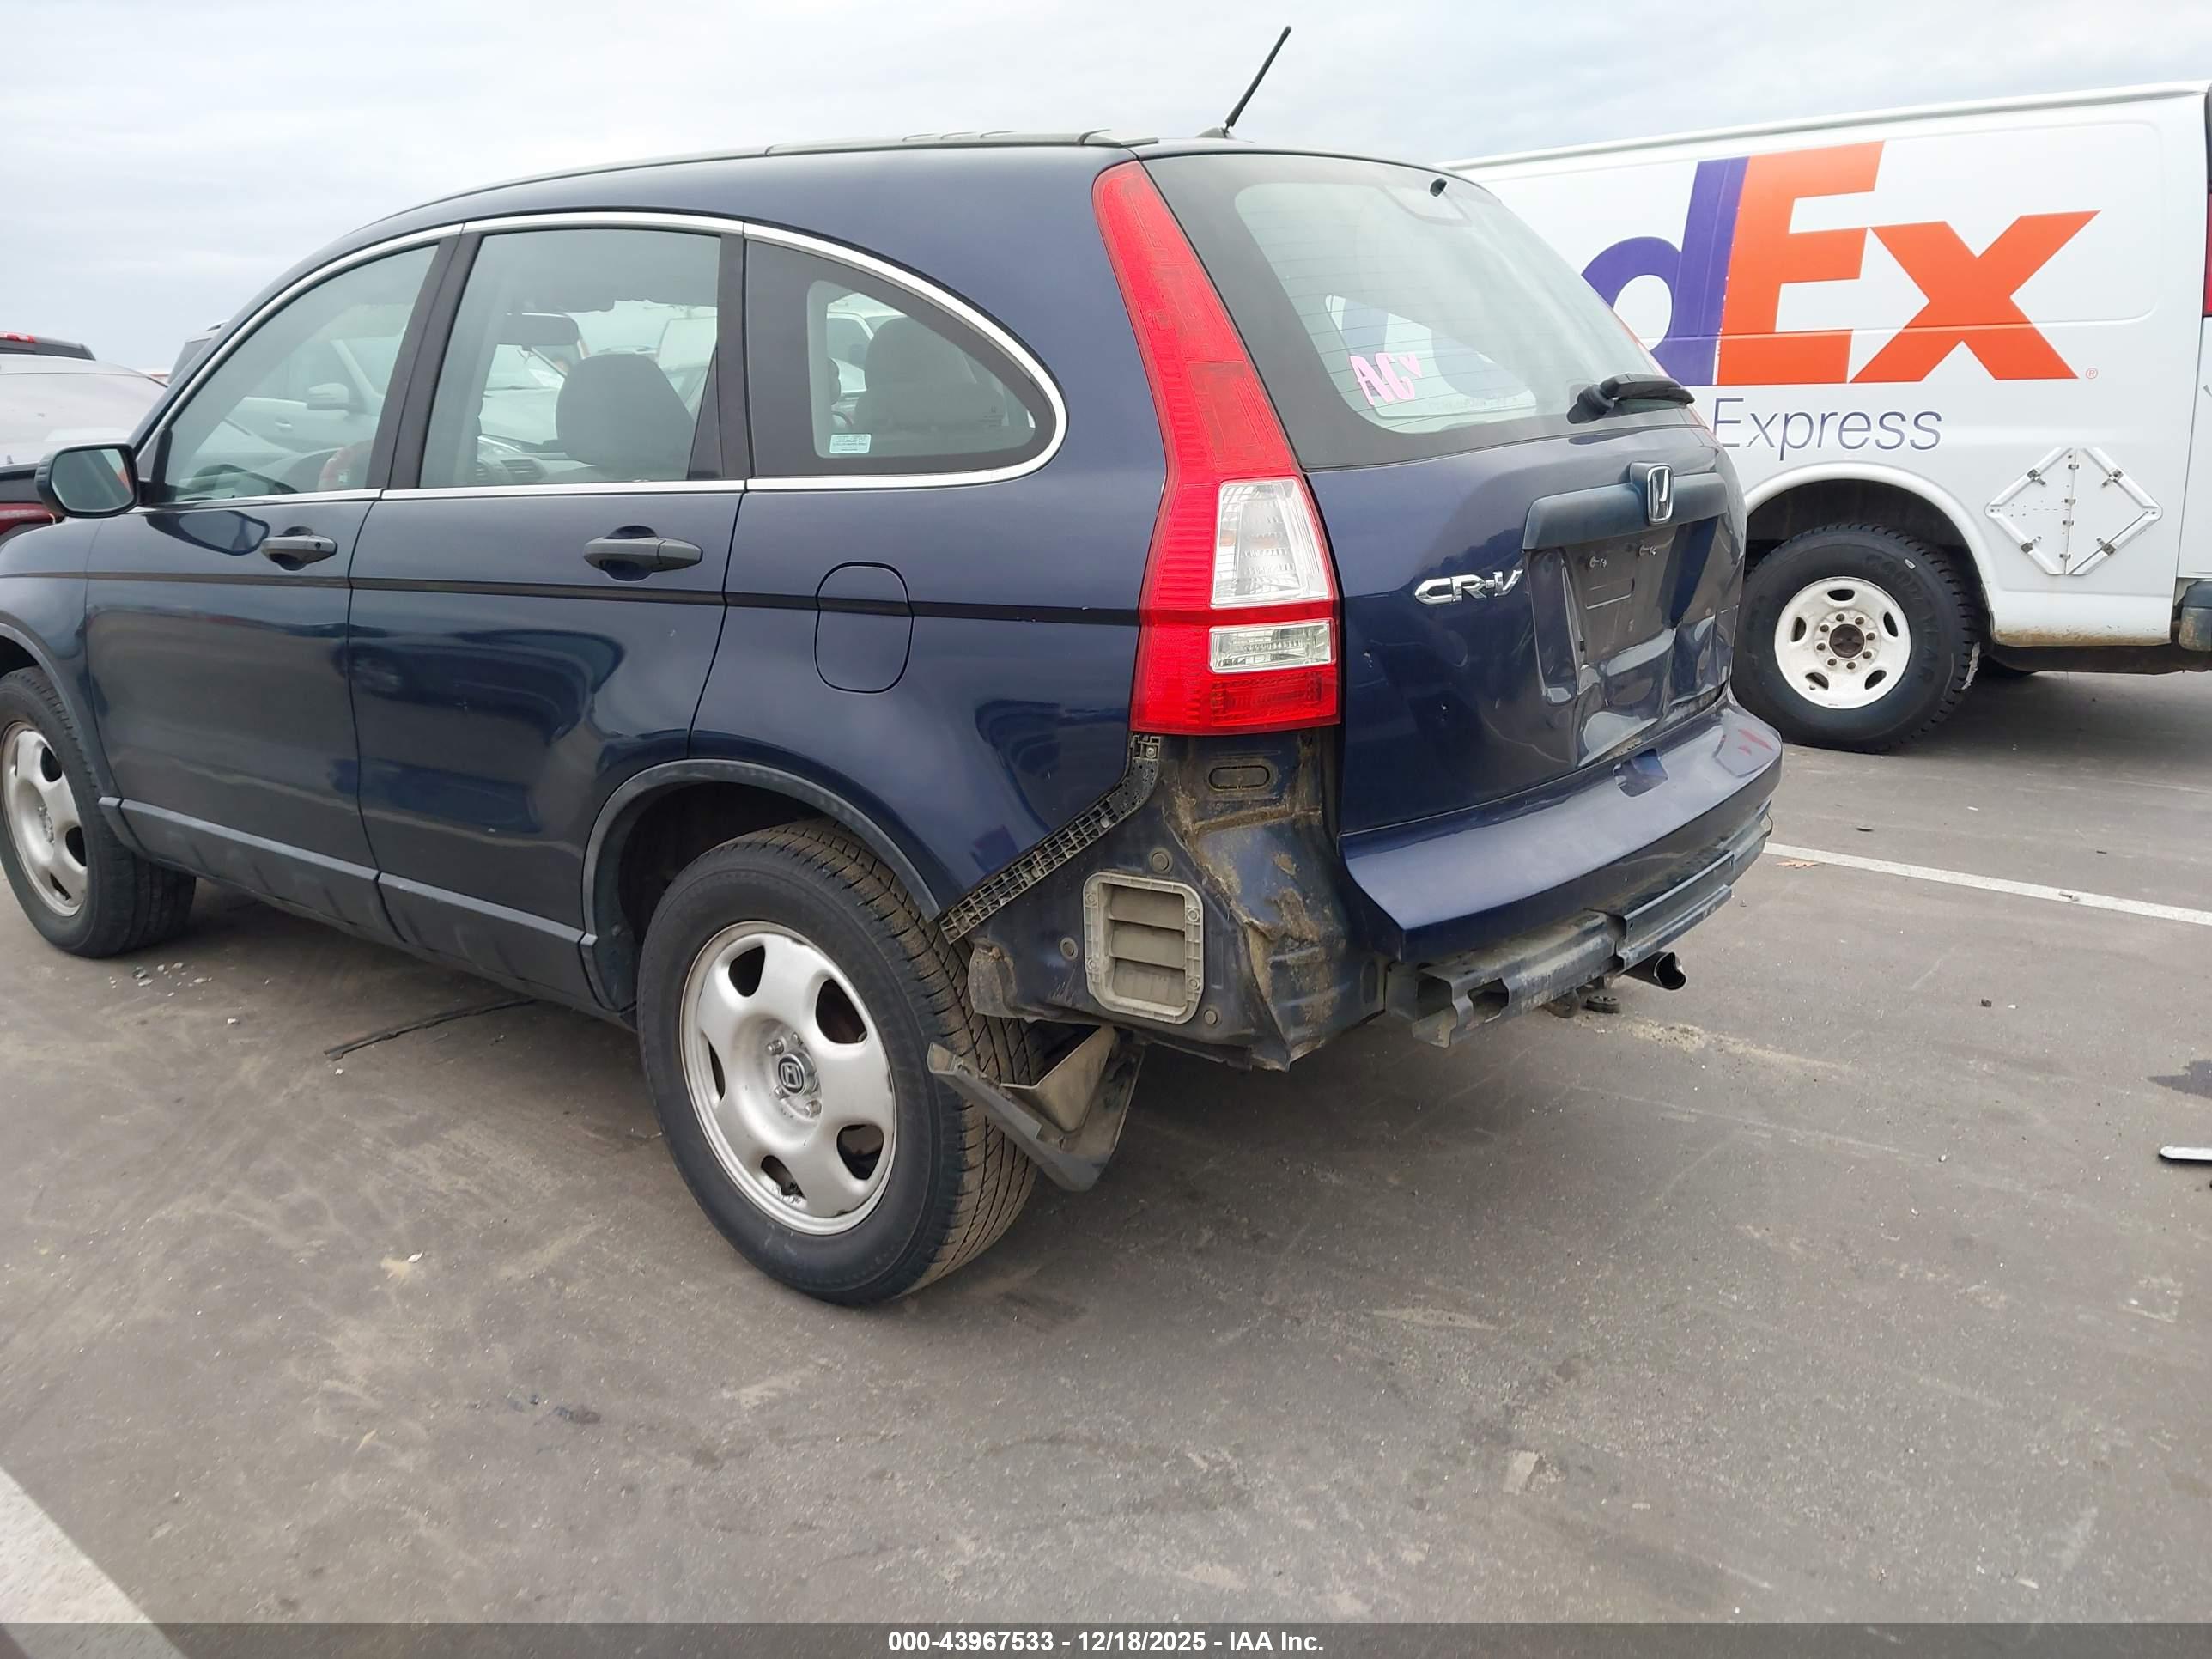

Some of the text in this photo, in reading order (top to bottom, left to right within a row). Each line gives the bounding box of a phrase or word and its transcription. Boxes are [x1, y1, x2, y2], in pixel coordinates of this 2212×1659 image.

[1583, 140, 2100, 387] dEx
[1711, 397, 1943, 460] Express
[1415, 568, 1524, 605] CR-V
